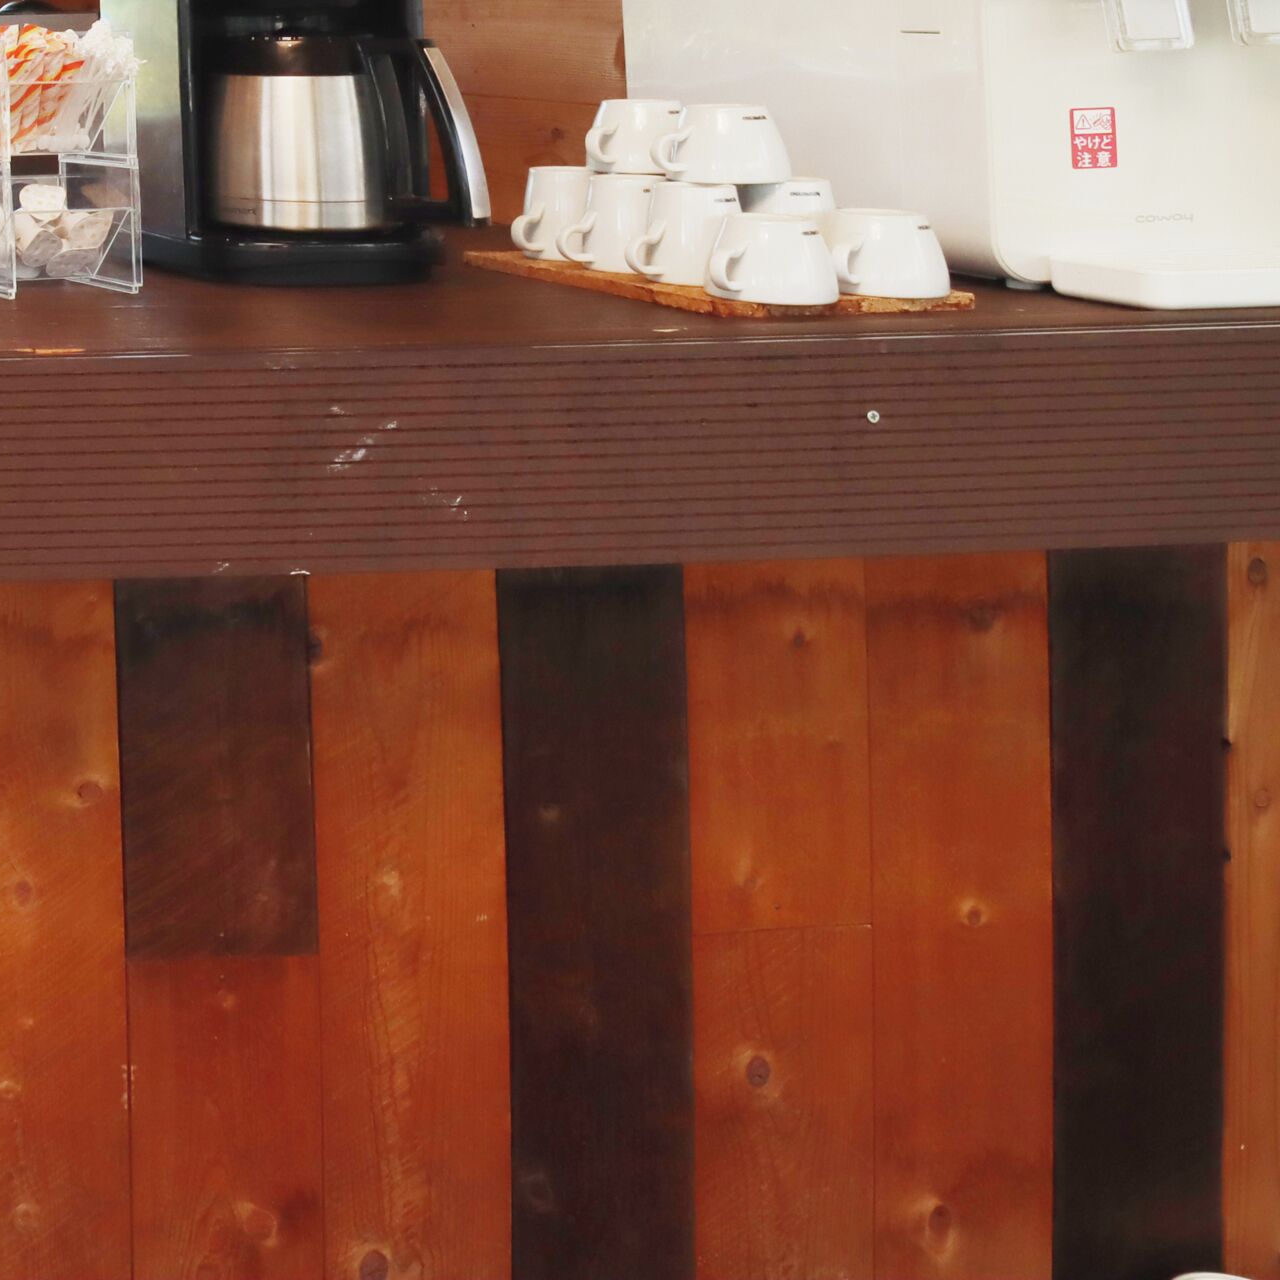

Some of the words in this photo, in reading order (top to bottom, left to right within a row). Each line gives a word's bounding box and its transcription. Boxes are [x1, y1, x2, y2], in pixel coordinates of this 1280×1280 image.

[1073, 134, 1113, 151] やけど
[1076, 150, 1112, 168] 注意
